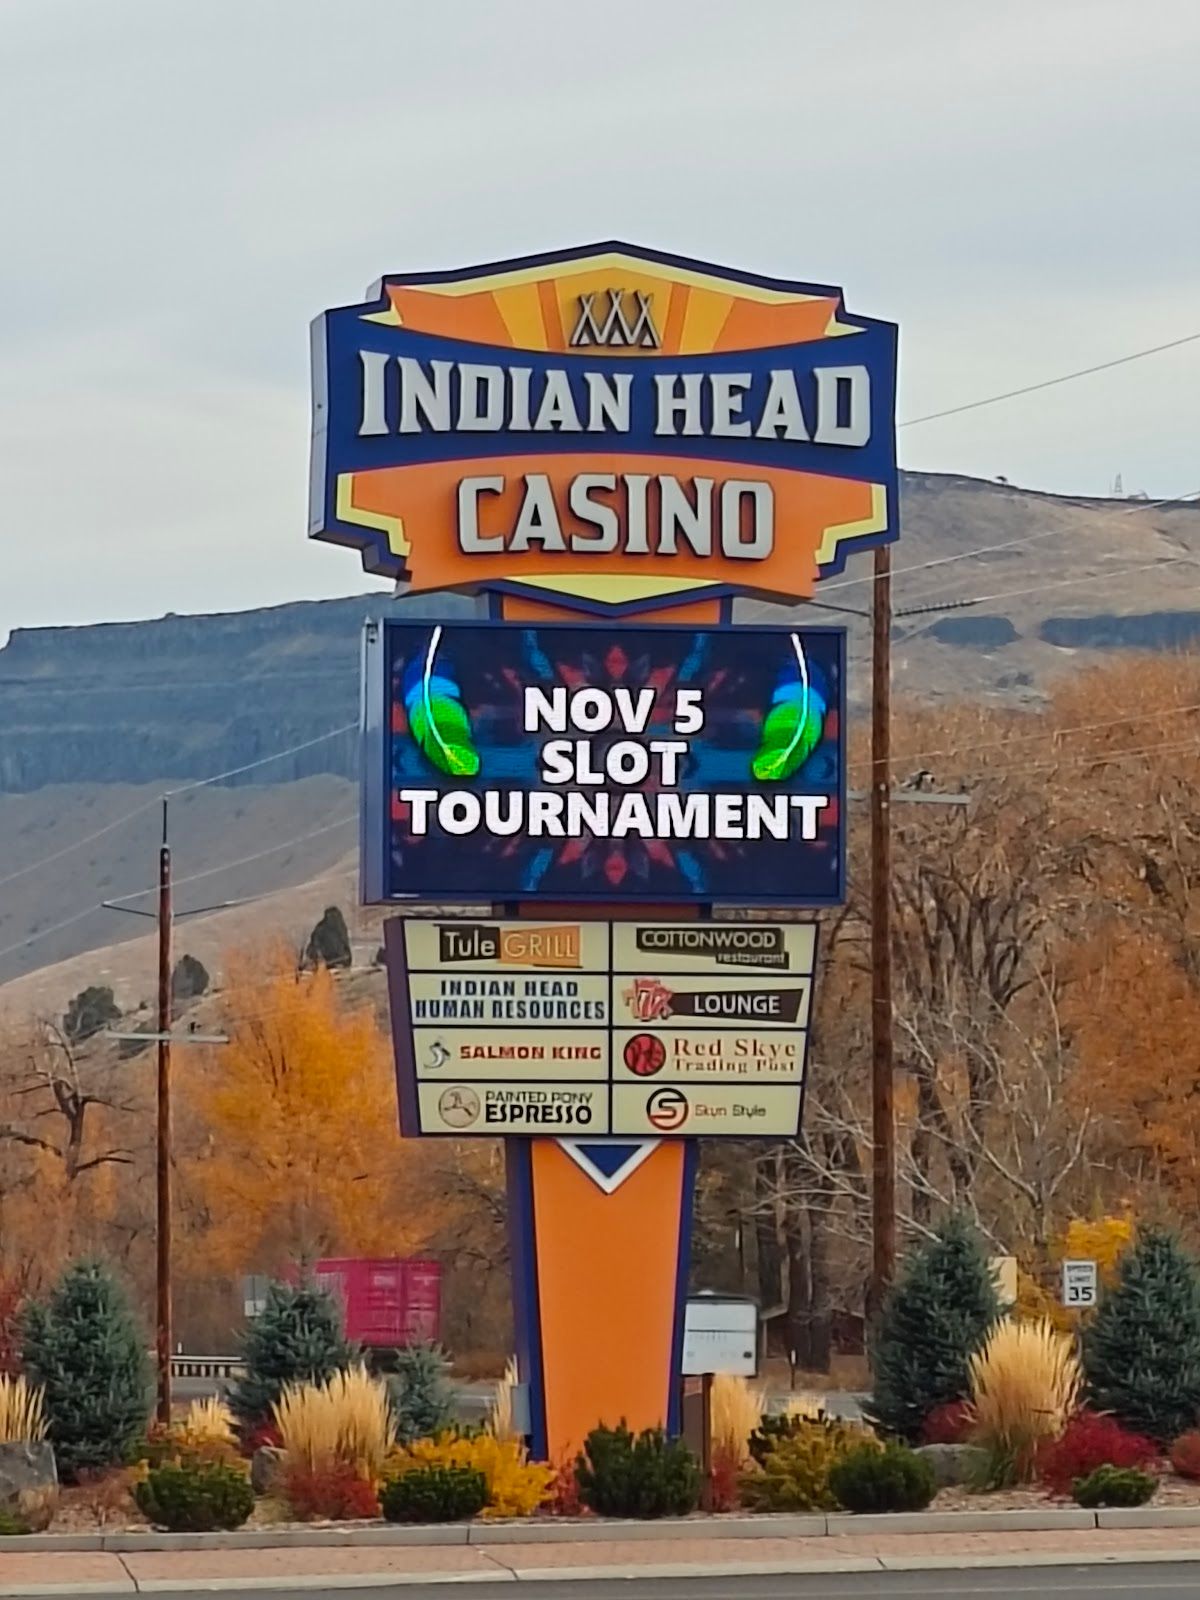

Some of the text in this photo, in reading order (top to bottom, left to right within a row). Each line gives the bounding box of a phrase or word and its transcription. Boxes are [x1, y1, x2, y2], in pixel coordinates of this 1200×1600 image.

[358, 350, 871, 447] INDIAN HEAD
[457, 474, 775, 560] CASINO
[523, 686, 704, 735] NOV 5
[541, 740, 690, 787] SLOT
[400, 789, 828, 840] TOURNAMENT
[443, 929, 577, 958] Tule GRILL
[641, 930, 777, 949] COTTONWOOD
[440, 980, 579, 998] INDIAN HEAD
[415, 999, 605, 1020] HUMAN RESOURCES
[693, 994, 780, 1014] LOUNGE
[460, 1045, 602, 1060] SALMON KING
[674, 1038, 796, 1058] Red Skye
[674, 1058, 748, 1074] Trading
[485, 1090, 593, 1105] PAINTED PONY
[484, 1104, 592, 1124] ESPRESSO
[1069, 1286, 1093, 1301] 35
